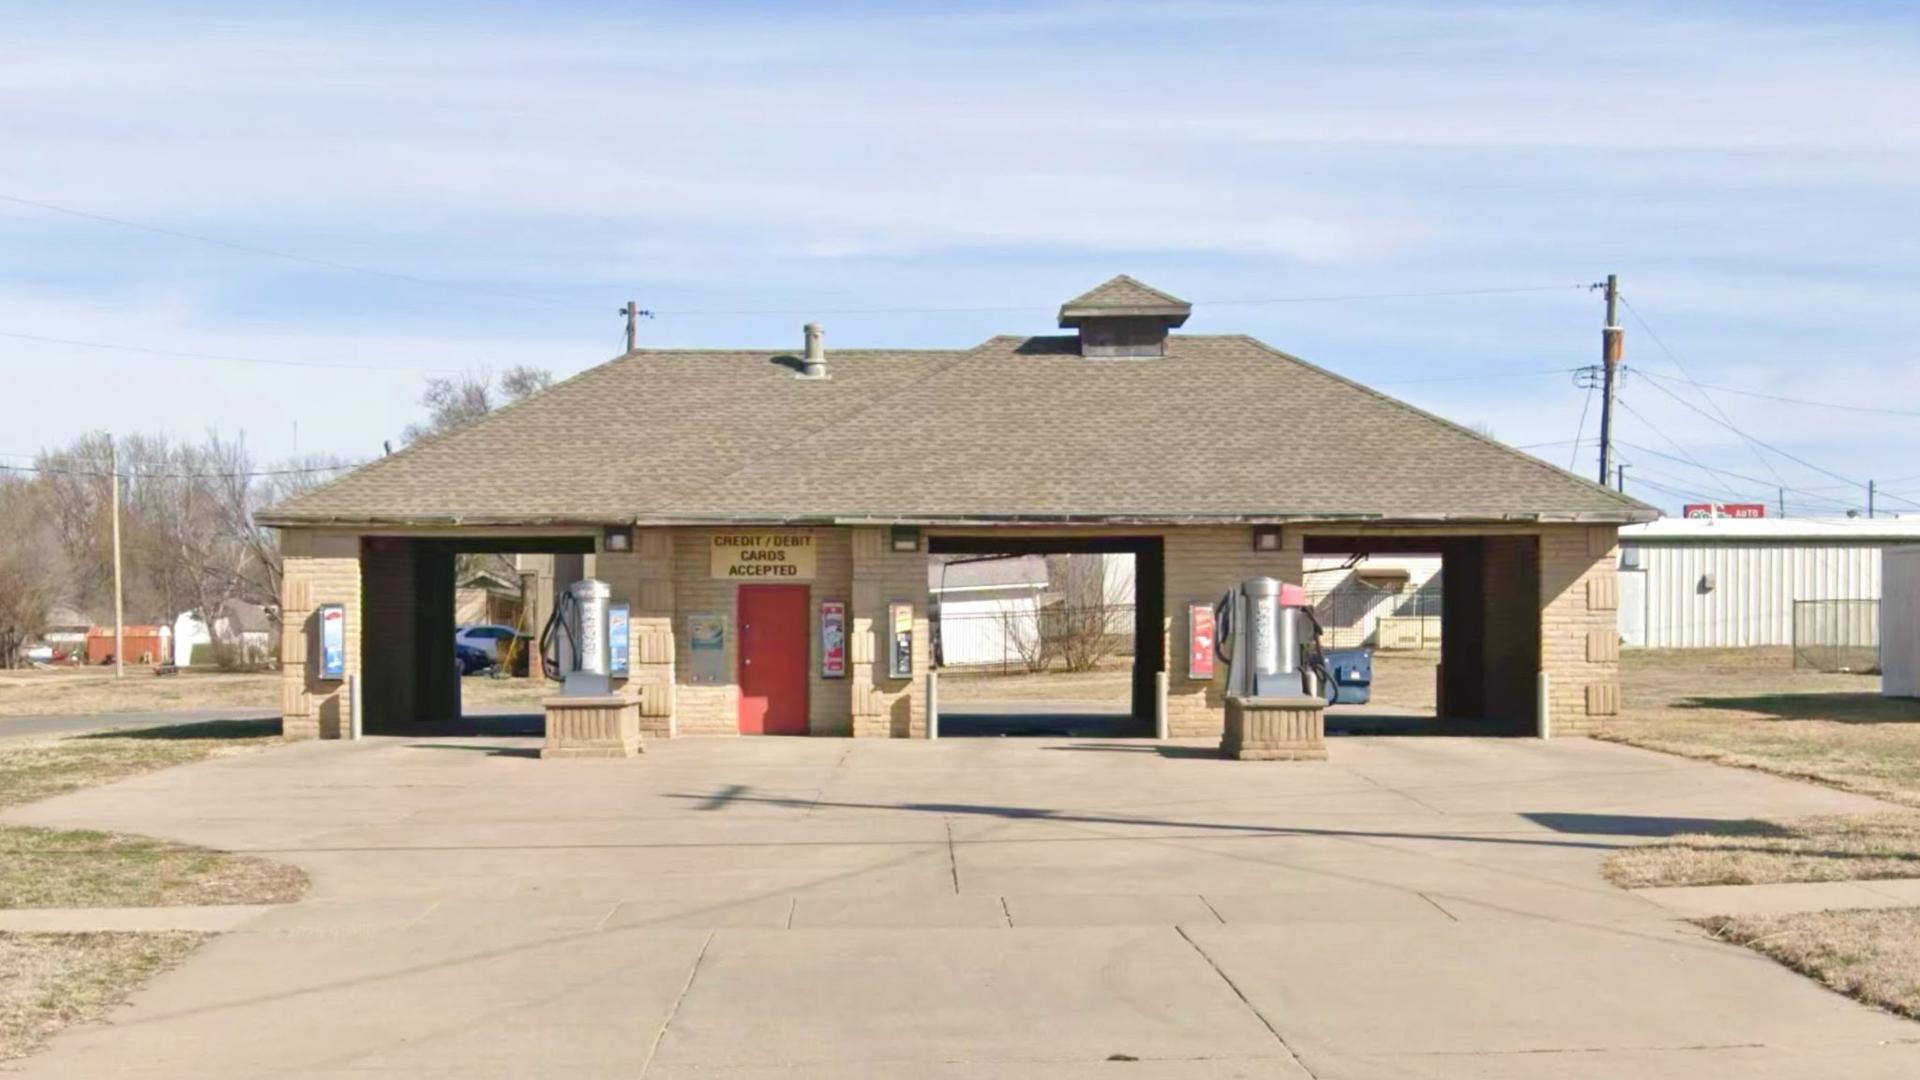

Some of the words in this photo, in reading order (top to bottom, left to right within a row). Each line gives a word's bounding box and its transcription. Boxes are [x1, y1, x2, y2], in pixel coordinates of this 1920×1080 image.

[714, 535, 761, 547] CREDIT
[773, 535, 811, 547] DEBIT
[740, 550, 786, 561] CARDS
[728, 564, 798, 576] ACCEPTED
